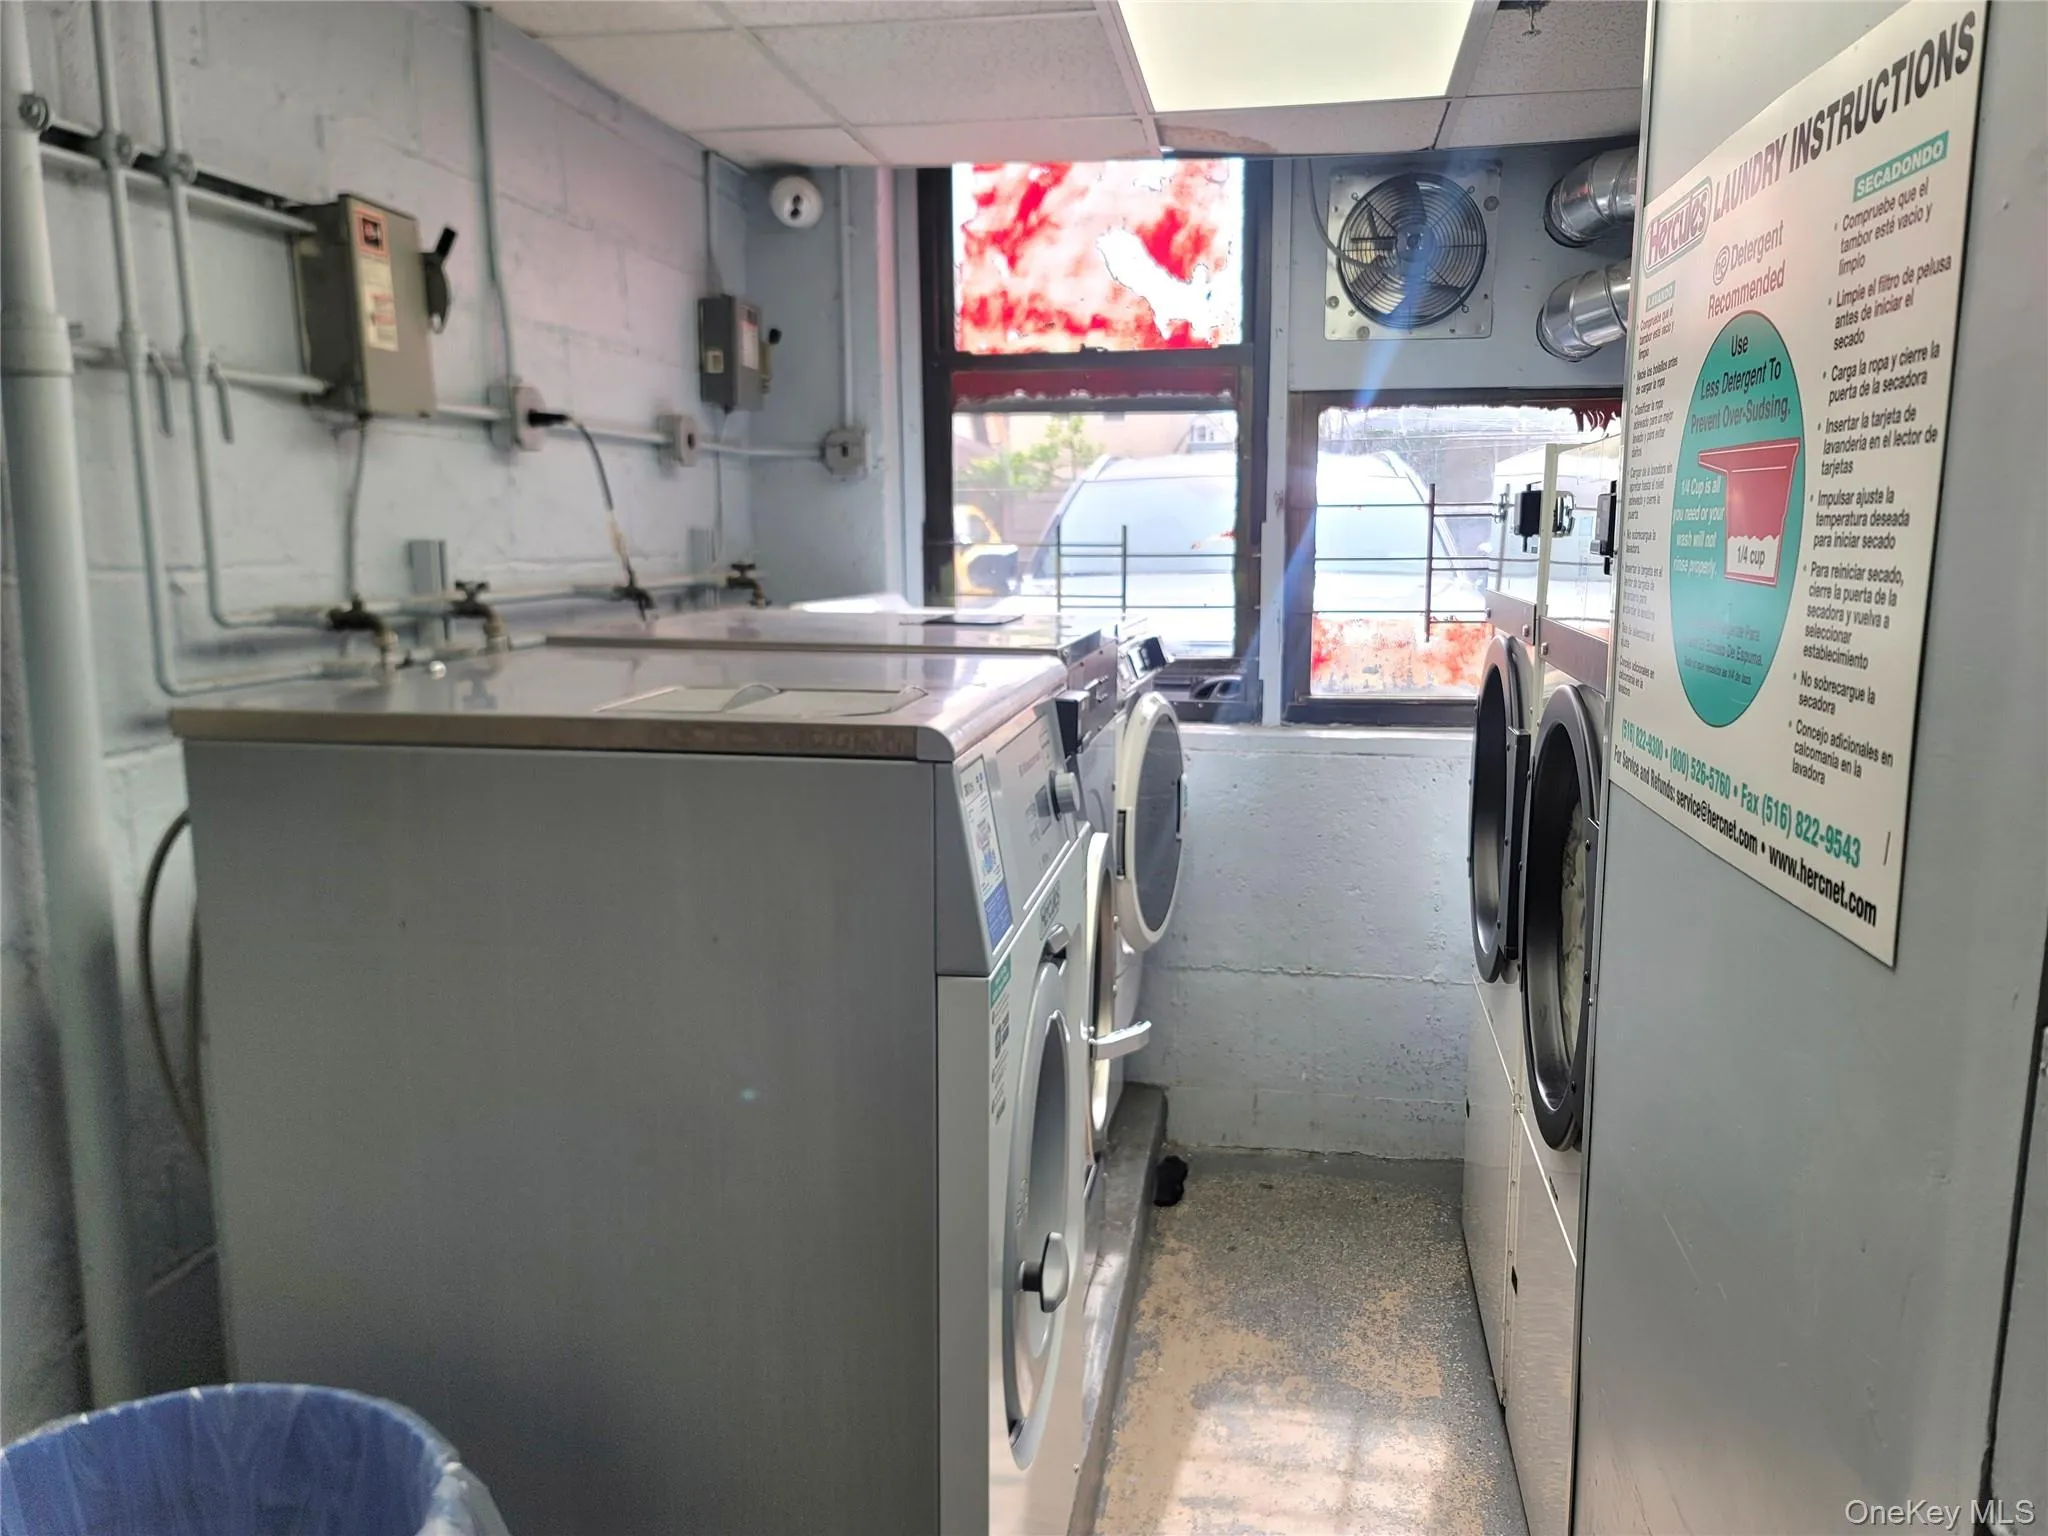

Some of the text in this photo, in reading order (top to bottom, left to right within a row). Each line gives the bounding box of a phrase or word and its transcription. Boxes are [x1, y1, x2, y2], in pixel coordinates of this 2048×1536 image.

[1648, 11, 1976, 268] Hercules LAUNDRY INSTRUCTIONS
[1857, 140, 1944, 196] SECADONDO
[1842, 176, 1929, 232] Compruebe que el
[1840, 228, 1872, 254] tambor
[1926, 202, 1933, 223] y
[1731, 220, 1784, 270] Detergent
[1838, 252, 1866, 276] limpio
[1708, 259, 1786, 319] Recommended
[1836, 256, 1952, 308] Limpie el filtro de pelusa
[1835, 287, 1914, 329] antes de iniciar el
[1731, 335, 1748, 357] Use
[1834, 327, 1865, 350] secado
[1831, 340, 1940, 383] Carga la ropa y cierre la
[1701, 357, 1782, 400] Less Detergent To
[1828, 370, 1928, 406] puerta de la secadora
[1691, 394, 1790, 434] Prevent Over-Sudsing.
[1825, 404, 1916, 434] Insertar la tarjeta de
[1870, 435, 1880, 450] en
[1882, 430, 1892, 448] el
[1893, 429, 1922, 447] lector
[1924, 425, 1938, 444] de
[1822, 459, 1854, 478] tarjetas
[1691, 479, 1704, 498] Cup
[1705, 477, 1711, 494] is
[1712, 476, 1721, 493] all
[1818, 486, 1894, 508] Impulsar ajuste la
[1672, 505, 1725, 525] you need or your
[1816, 509, 1910, 530] temperatura deseada
[1676, 530, 1716, 548] wash will not
[1813, 530, 1896, 550] para iniciar secado
[1673, 555, 1689, 572] rinse
[1738, 545, 1766, 570] 1/4 cup
[1811, 561, 1904, 588] Para reiniciar secado,
[1809, 581, 1898, 607] cierre la puerta de la
[1807, 604, 1890, 629] secadora y vuelva a
[1805, 623, 1852, 644] seleccionar
[1803, 644, 1869, 670] establecimiento
[1800, 670, 1876, 705] No sobrecargue la
[1798, 694, 1836, 715] secadora
[1796, 719, 1894, 768] Concejo adicionales en
[1792, 757, 1826, 785] lavadora
[1842, 760, 1852, 775] en
[1854, 760, 1862, 778] la
[1622, 718, 1634, 748] (516)
[1670, 746, 1689, 782] (800)
[1691, 758, 1731, 800] 526-5760
[1741, 782, 1760, 816] Fax
[1762, 794, 1792, 839] (516)
[1795, 811, 1861, 868] 822-9543
[1614, 744, 1876, 927] For Service and Refunds: service@hercnet.com www.hercnet.com
